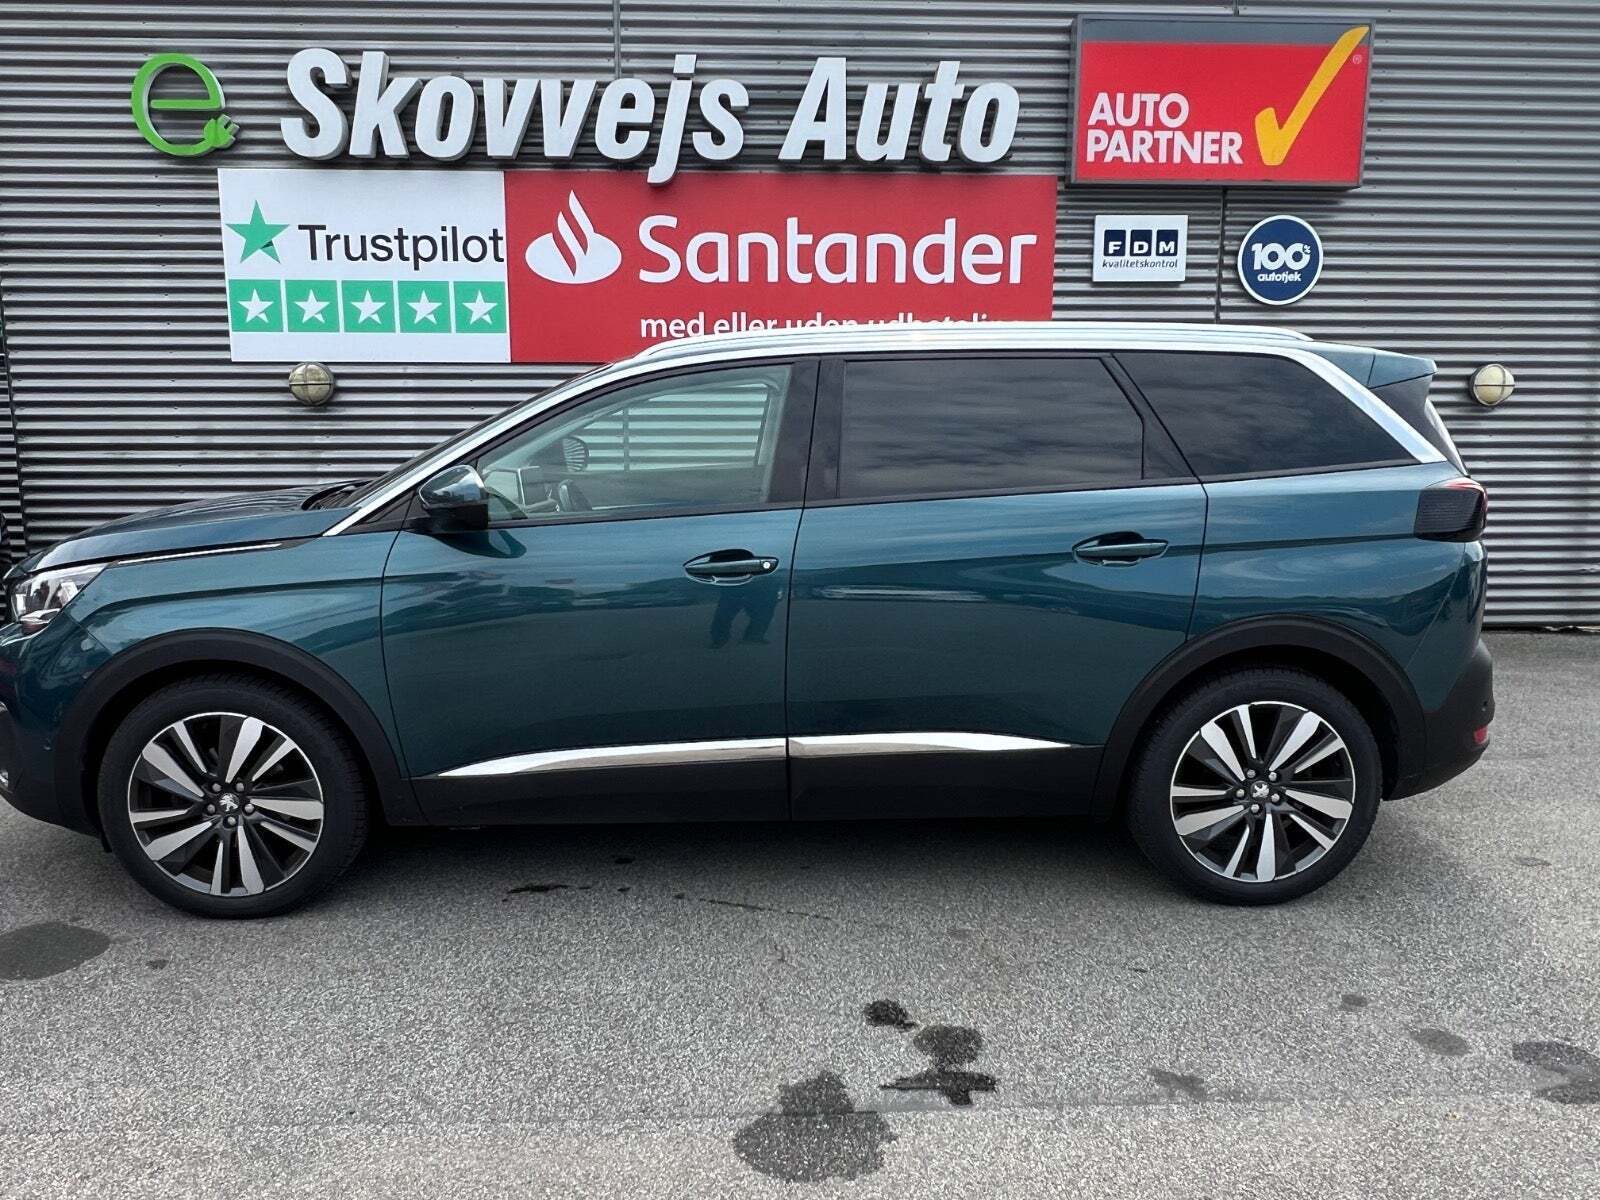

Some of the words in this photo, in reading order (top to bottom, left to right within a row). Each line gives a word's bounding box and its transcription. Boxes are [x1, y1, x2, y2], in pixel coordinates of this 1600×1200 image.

[280, 48, 750, 184] Skovvejs
[778, 57, 1020, 163] Auto
[1087, 92, 1190, 128] AUTO
[1086, 129, 1244, 165] PARTNER
[298, 223, 505, 271] Trustpilot
[638, 214, 1038, 285] Santander
[1102, 259, 1178, 269] kvalitetskontrol
[1108, 241, 1175, 254] FDM
[1257, 271, 1302, 284] autotjek
[640, 311, 705, 338] med
[713, 311, 777, 335] eller
